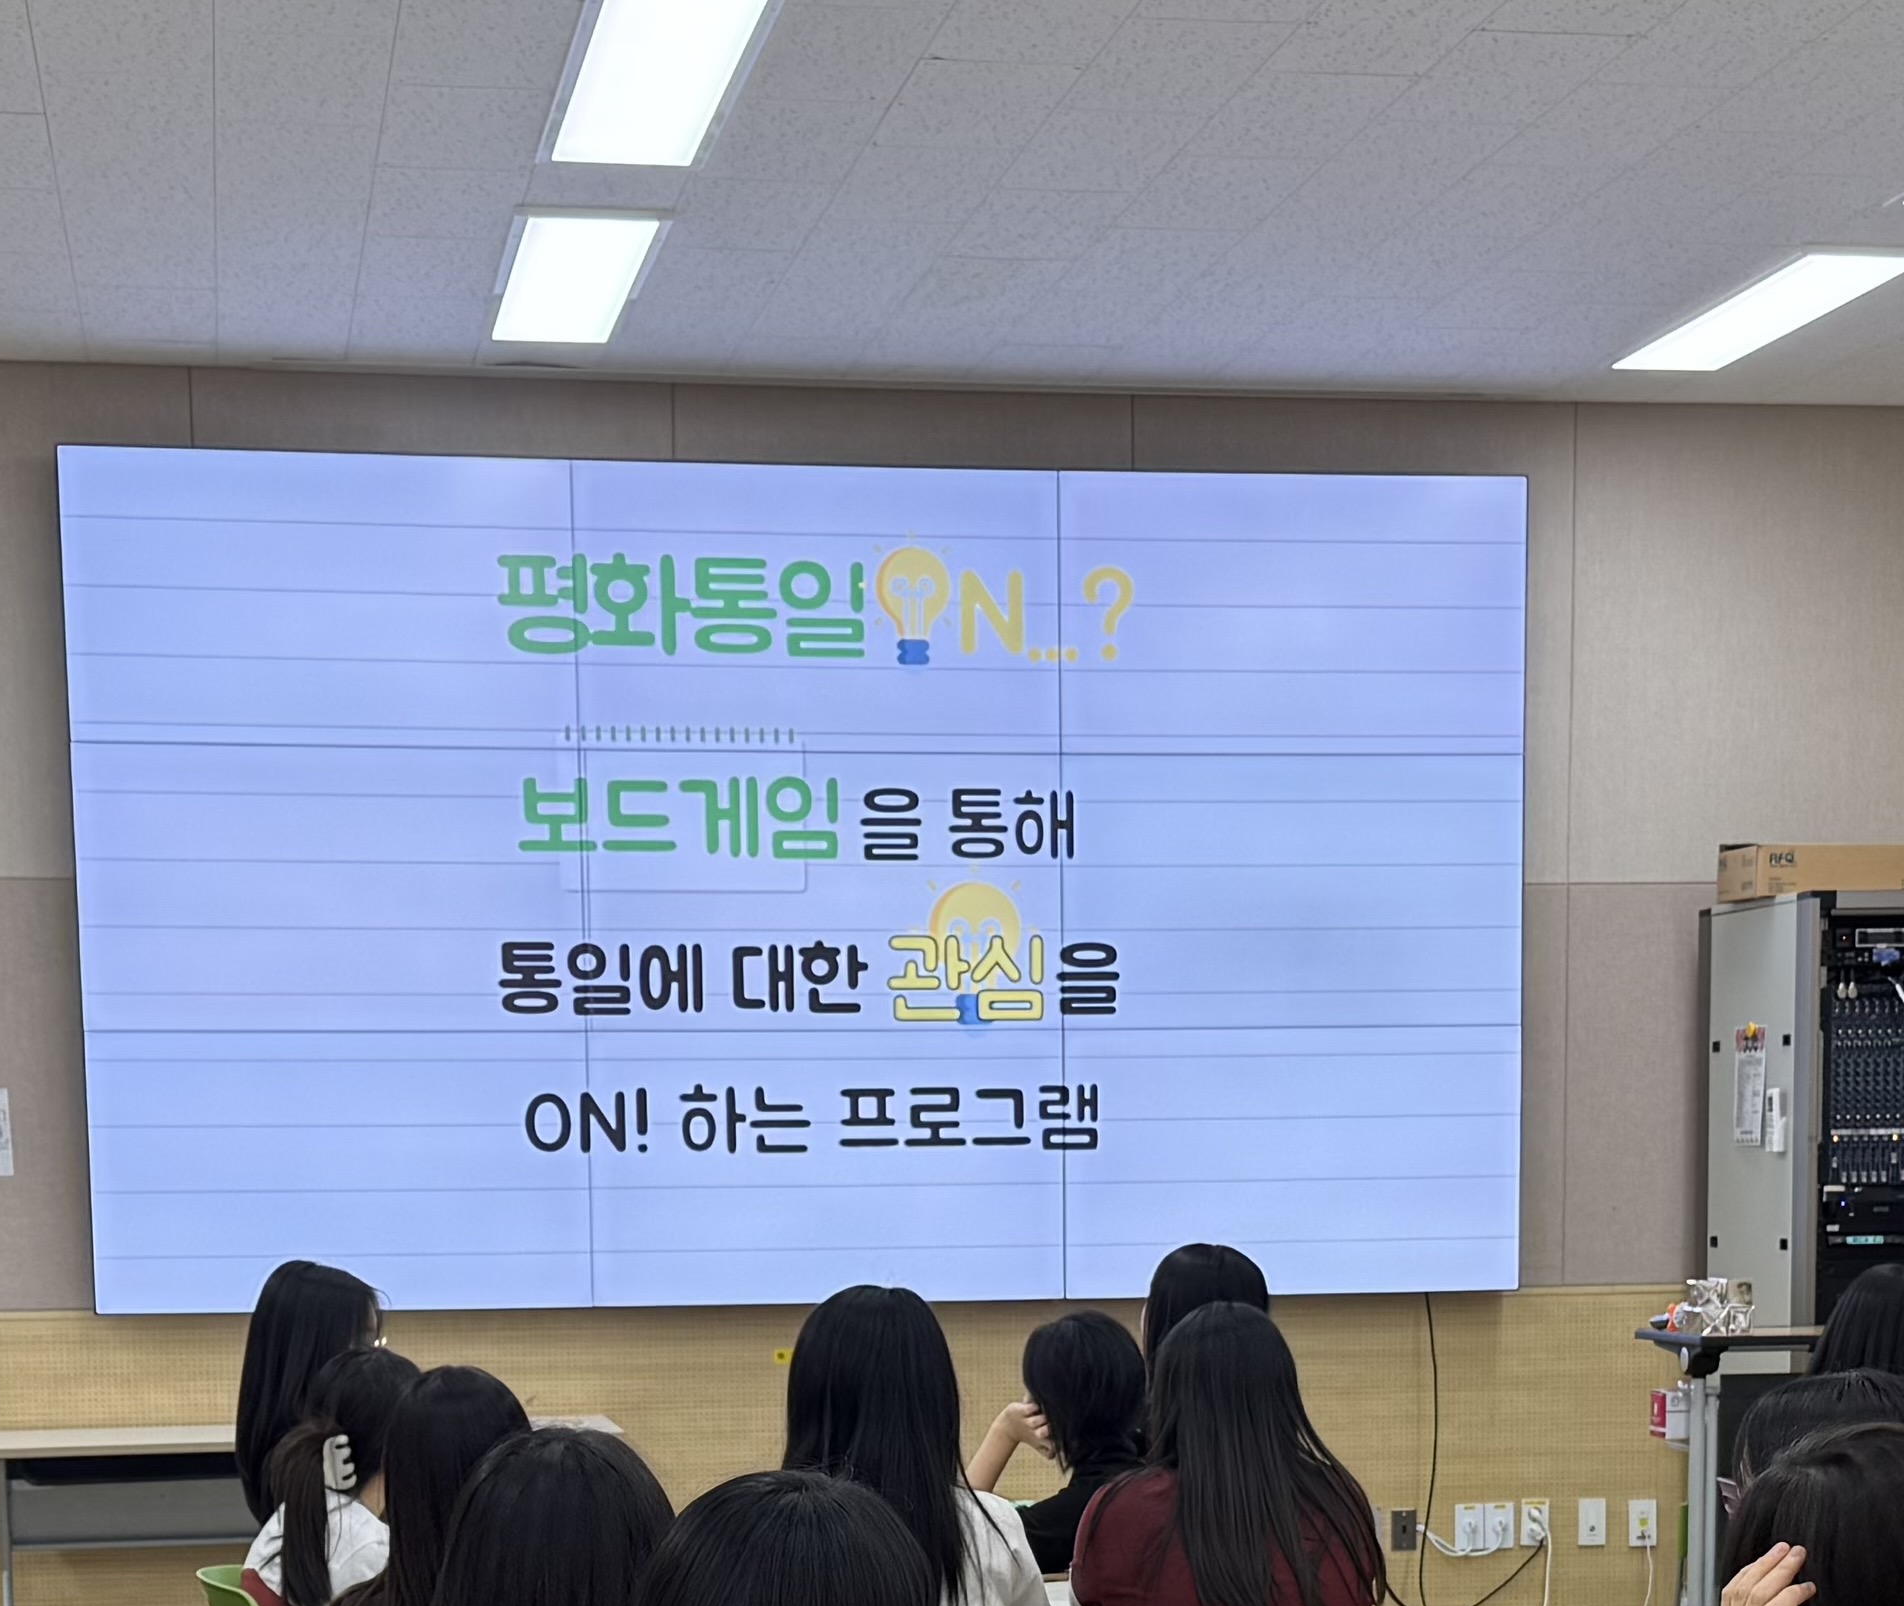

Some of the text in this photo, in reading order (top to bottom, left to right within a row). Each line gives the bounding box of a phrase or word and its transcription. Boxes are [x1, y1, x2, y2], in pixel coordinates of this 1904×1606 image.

[948, 787, 1074, 860] 통해
[498, 941, 704, 1016] 통일에
[731, 939, 869, 1014] 대한
[524, 1082, 1099, 1154] ON! 하는 프로그램
